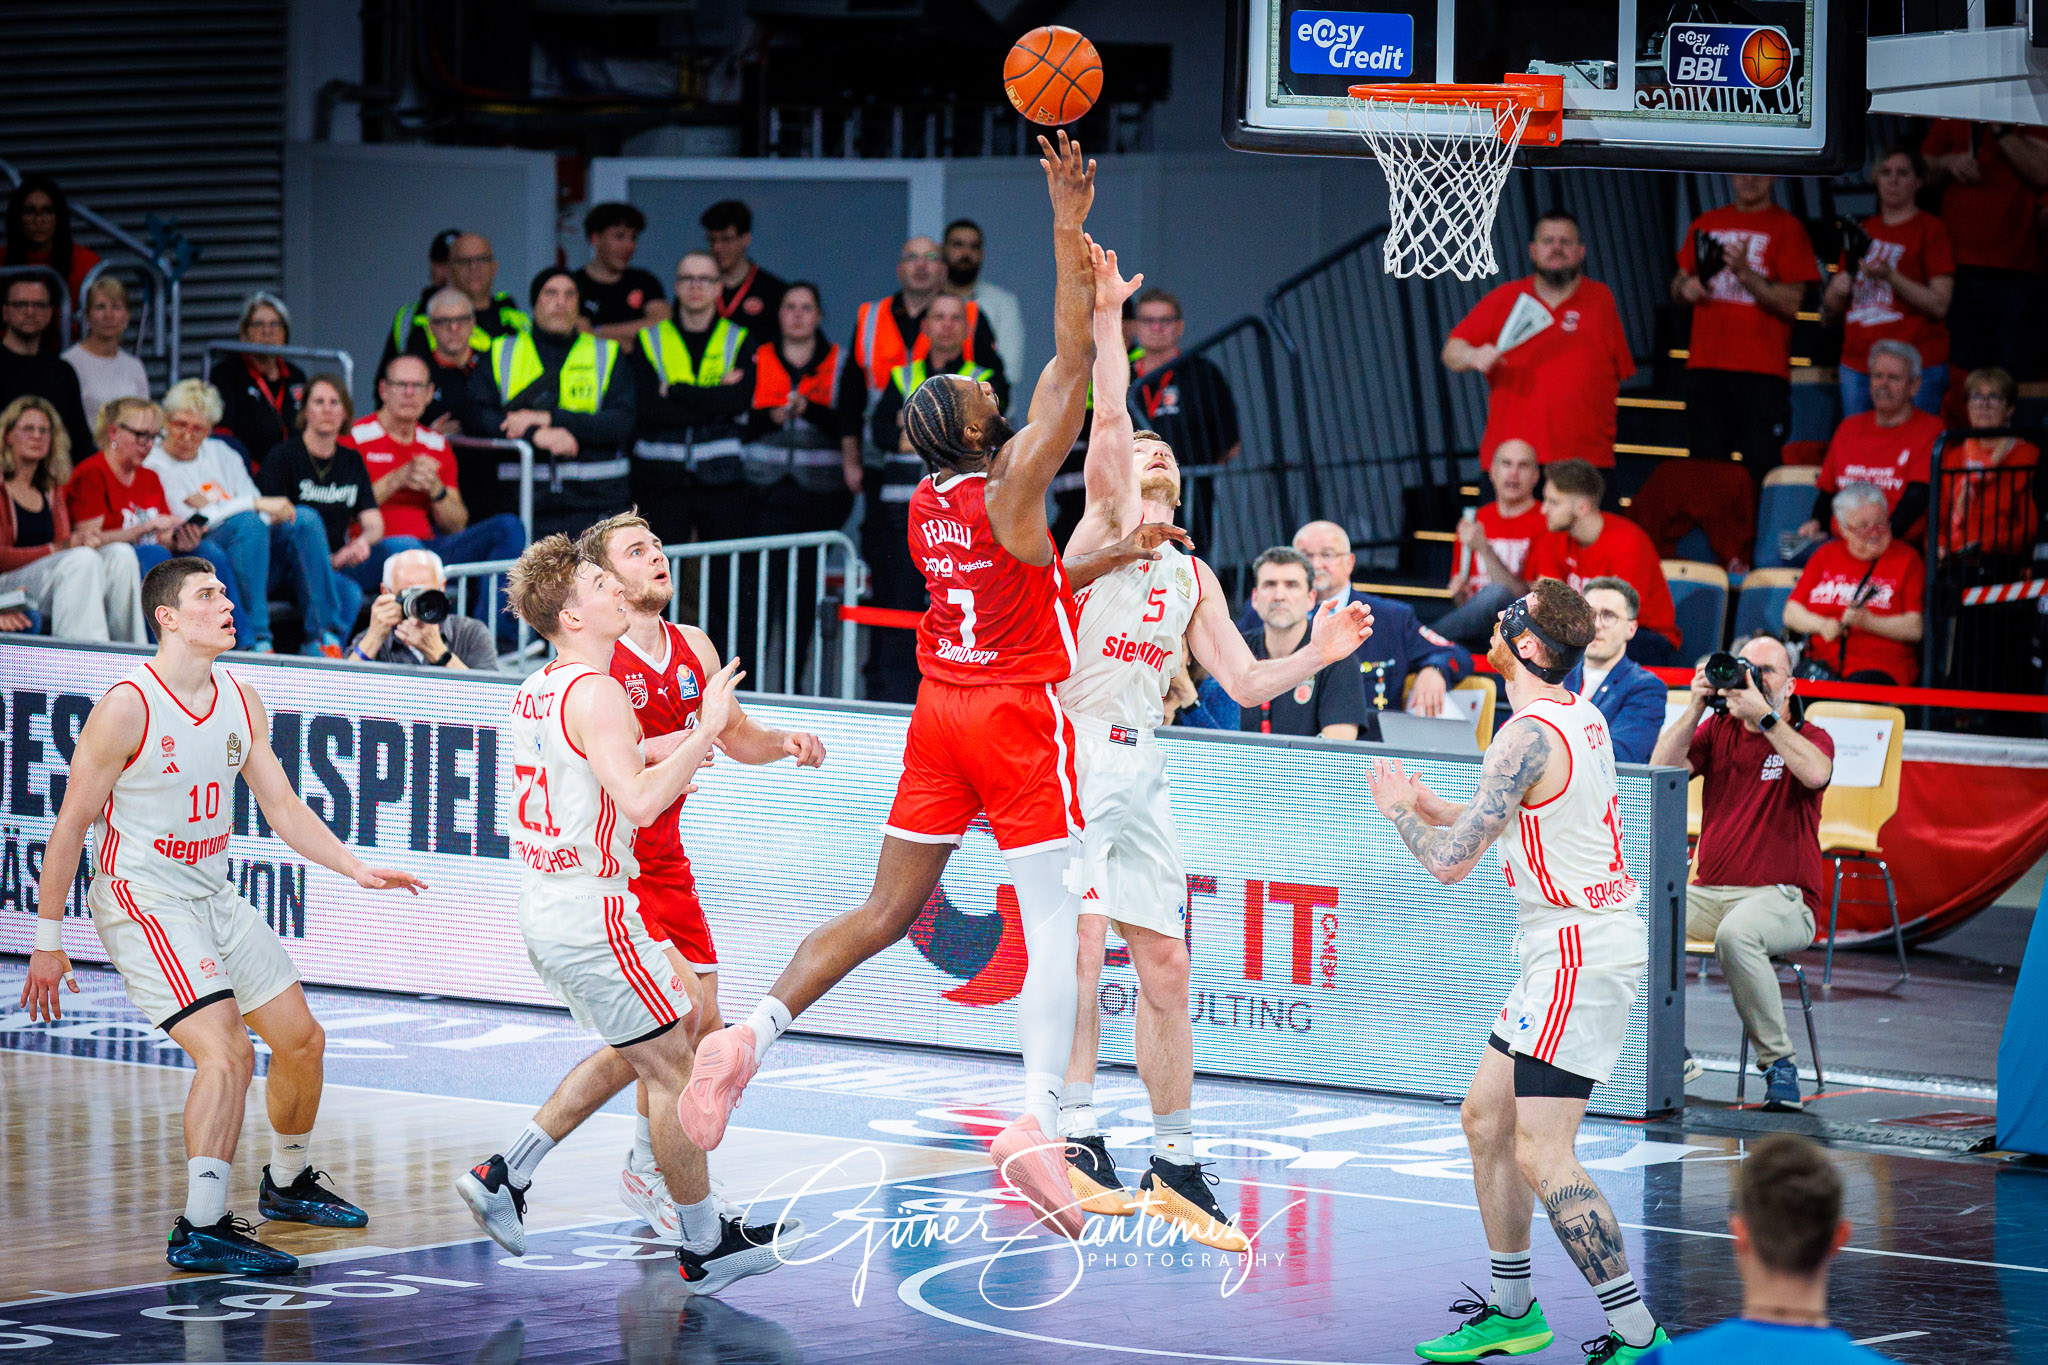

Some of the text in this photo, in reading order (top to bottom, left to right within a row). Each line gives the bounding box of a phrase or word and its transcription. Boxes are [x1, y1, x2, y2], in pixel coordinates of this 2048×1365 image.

[1328, 43, 1404, 70] Credit
[1692, 43, 1730, 56] Credit
[1676, 56, 1728, 82] BBL
[958, 559, 993, 573] logistics
[947, 588, 977, 649] 7
[1142, 586, 1167, 622] 5
[188, 781, 220, 823] 10
[1242, 878, 1339, 986] IT
